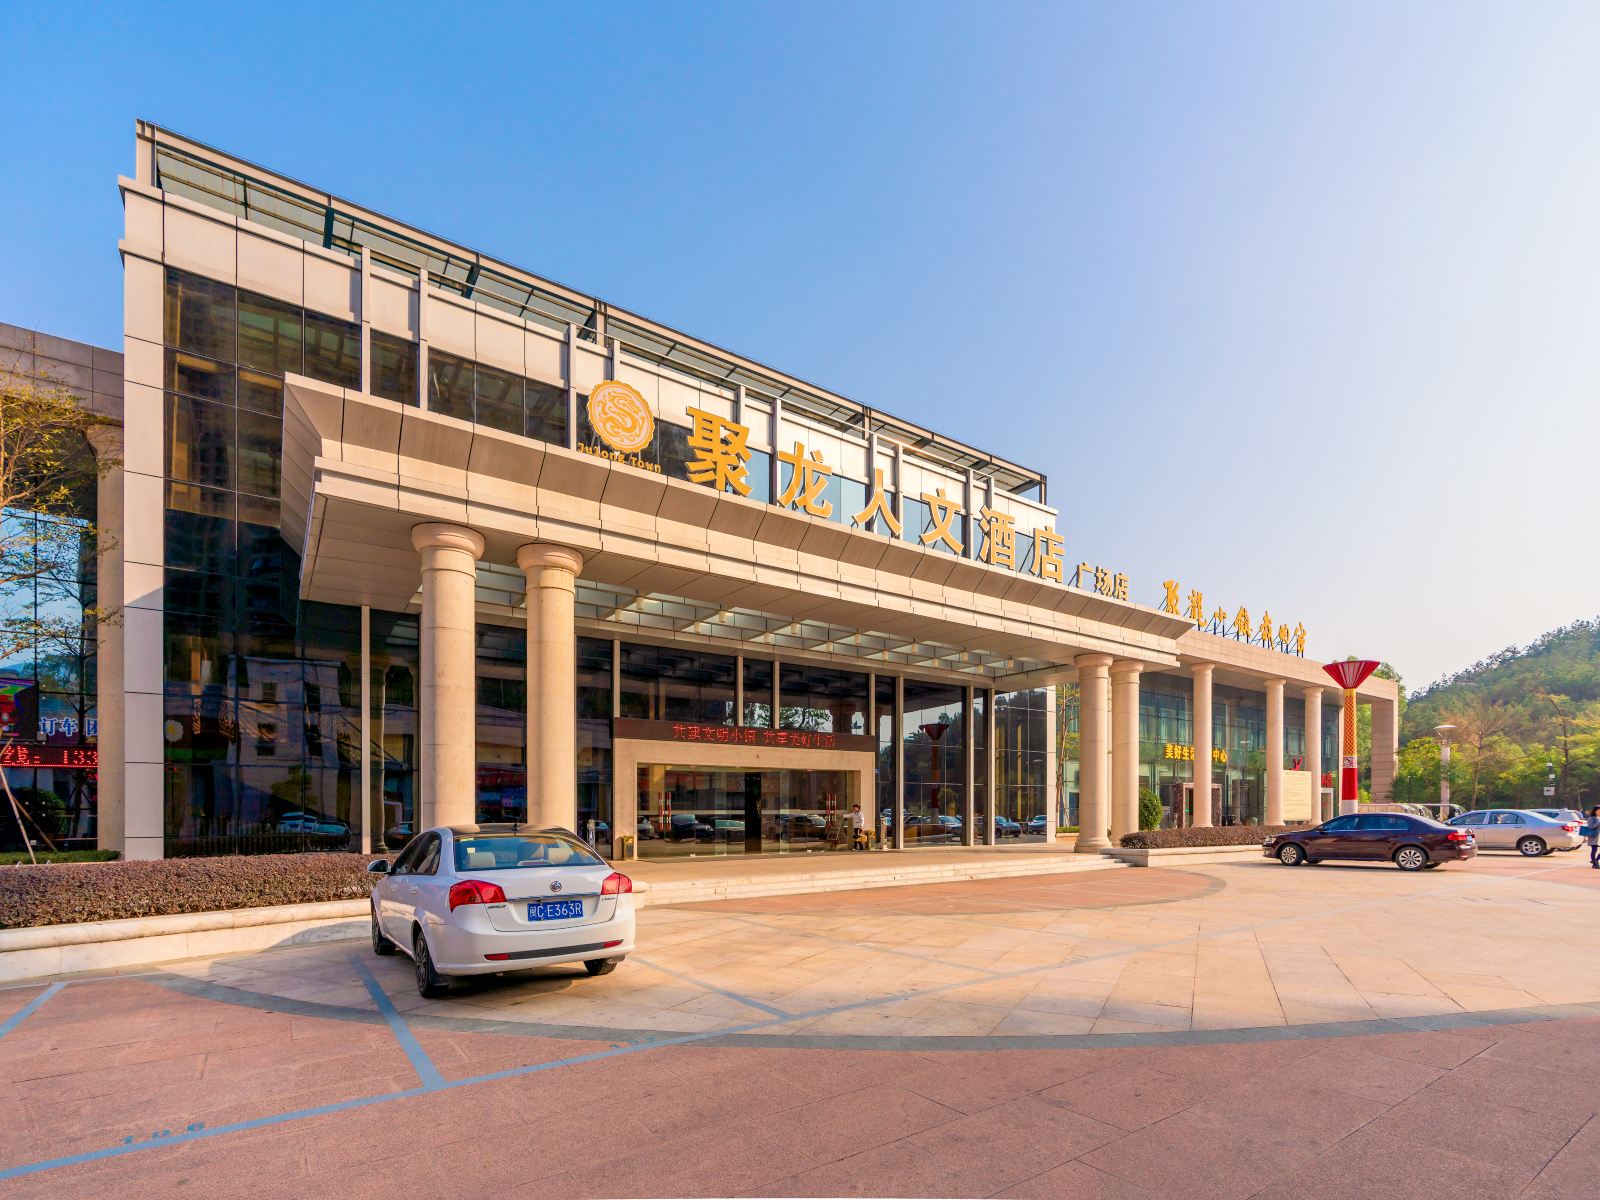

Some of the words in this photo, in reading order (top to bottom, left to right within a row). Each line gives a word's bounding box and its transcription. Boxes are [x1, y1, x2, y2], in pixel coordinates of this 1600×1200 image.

[686, 406, 1065, 583] 聚龙人文酒店
[1076, 562, 1130, 601] 广场店
[39, 717, 78, 737] 订车
[672, 723, 757, 744] 共建文明小镇
